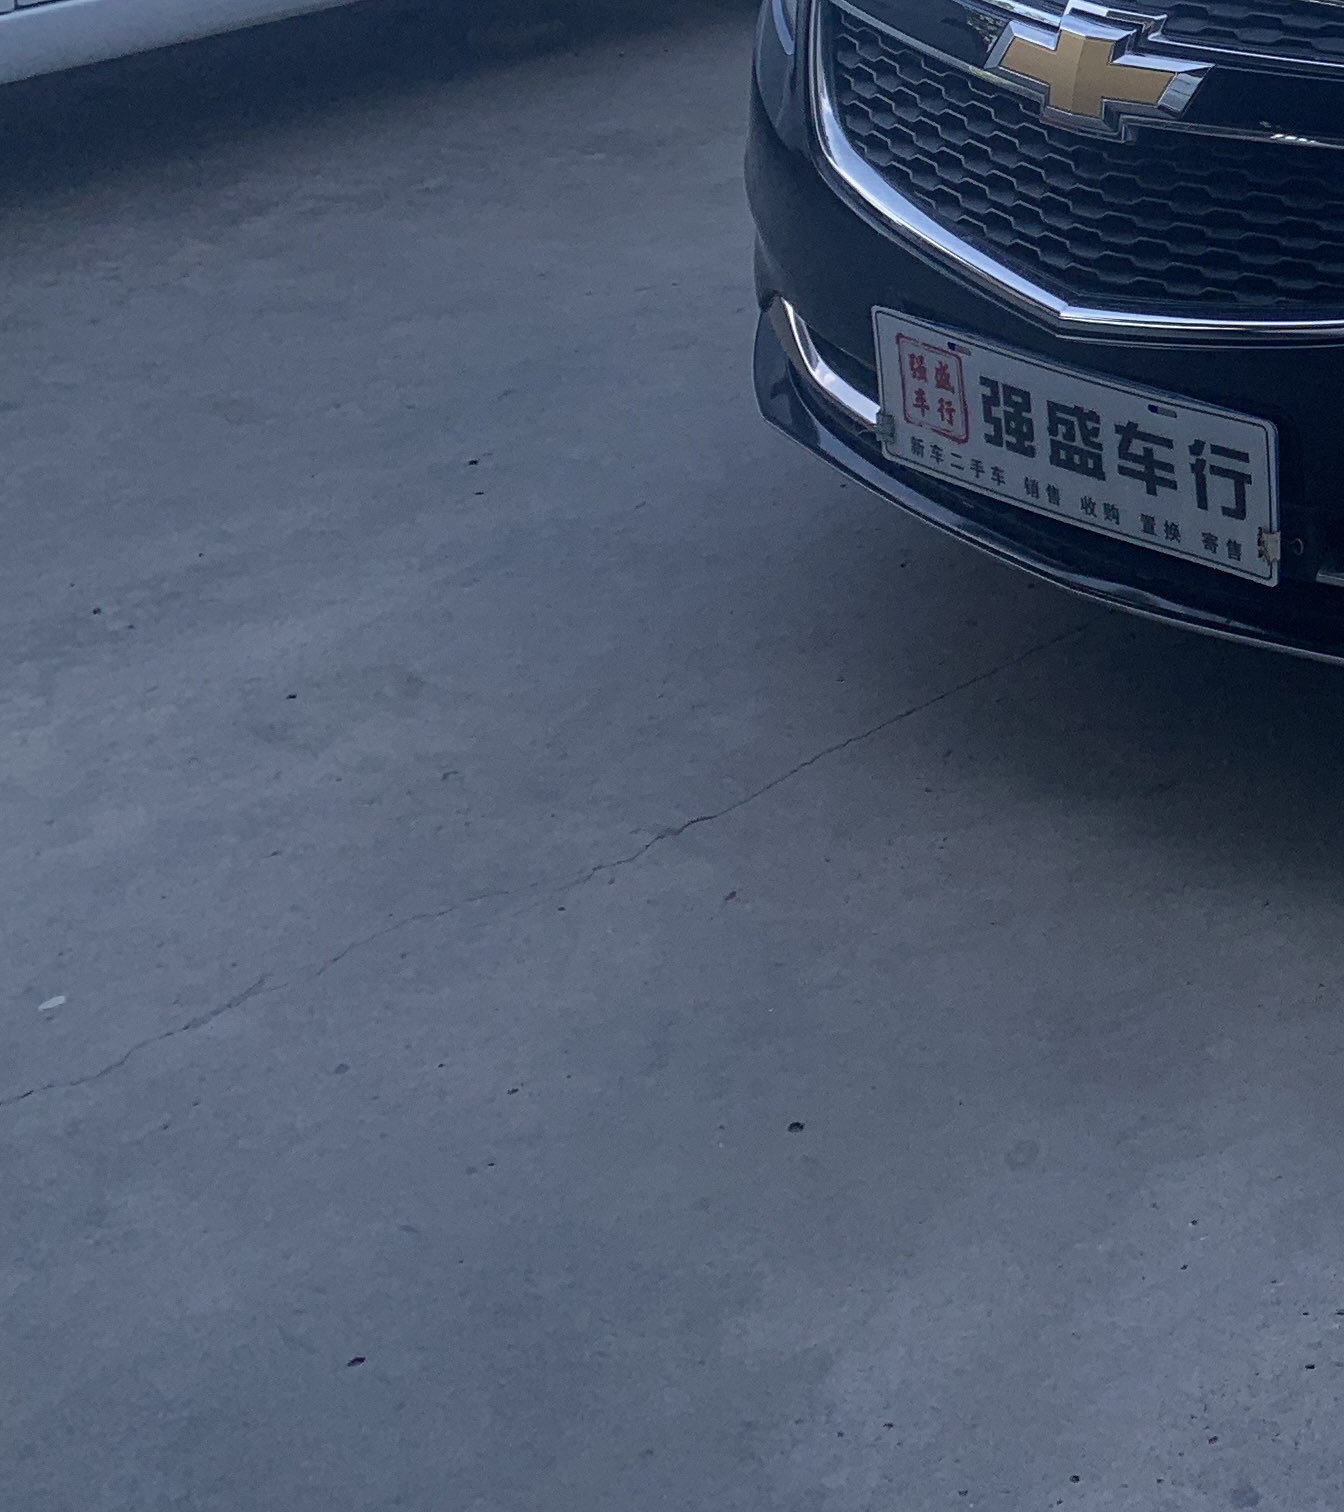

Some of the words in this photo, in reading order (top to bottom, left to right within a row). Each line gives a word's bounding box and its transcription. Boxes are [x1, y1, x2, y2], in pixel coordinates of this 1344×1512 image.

[911, 436, 1006, 486] 新车二手车
[1080, 495, 1120, 526] 收购
[1140, 513, 1181, 544] 置换
[1201, 532, 1242, 562] 寄售
[979, 375, 1252, 521] 强盛车行
